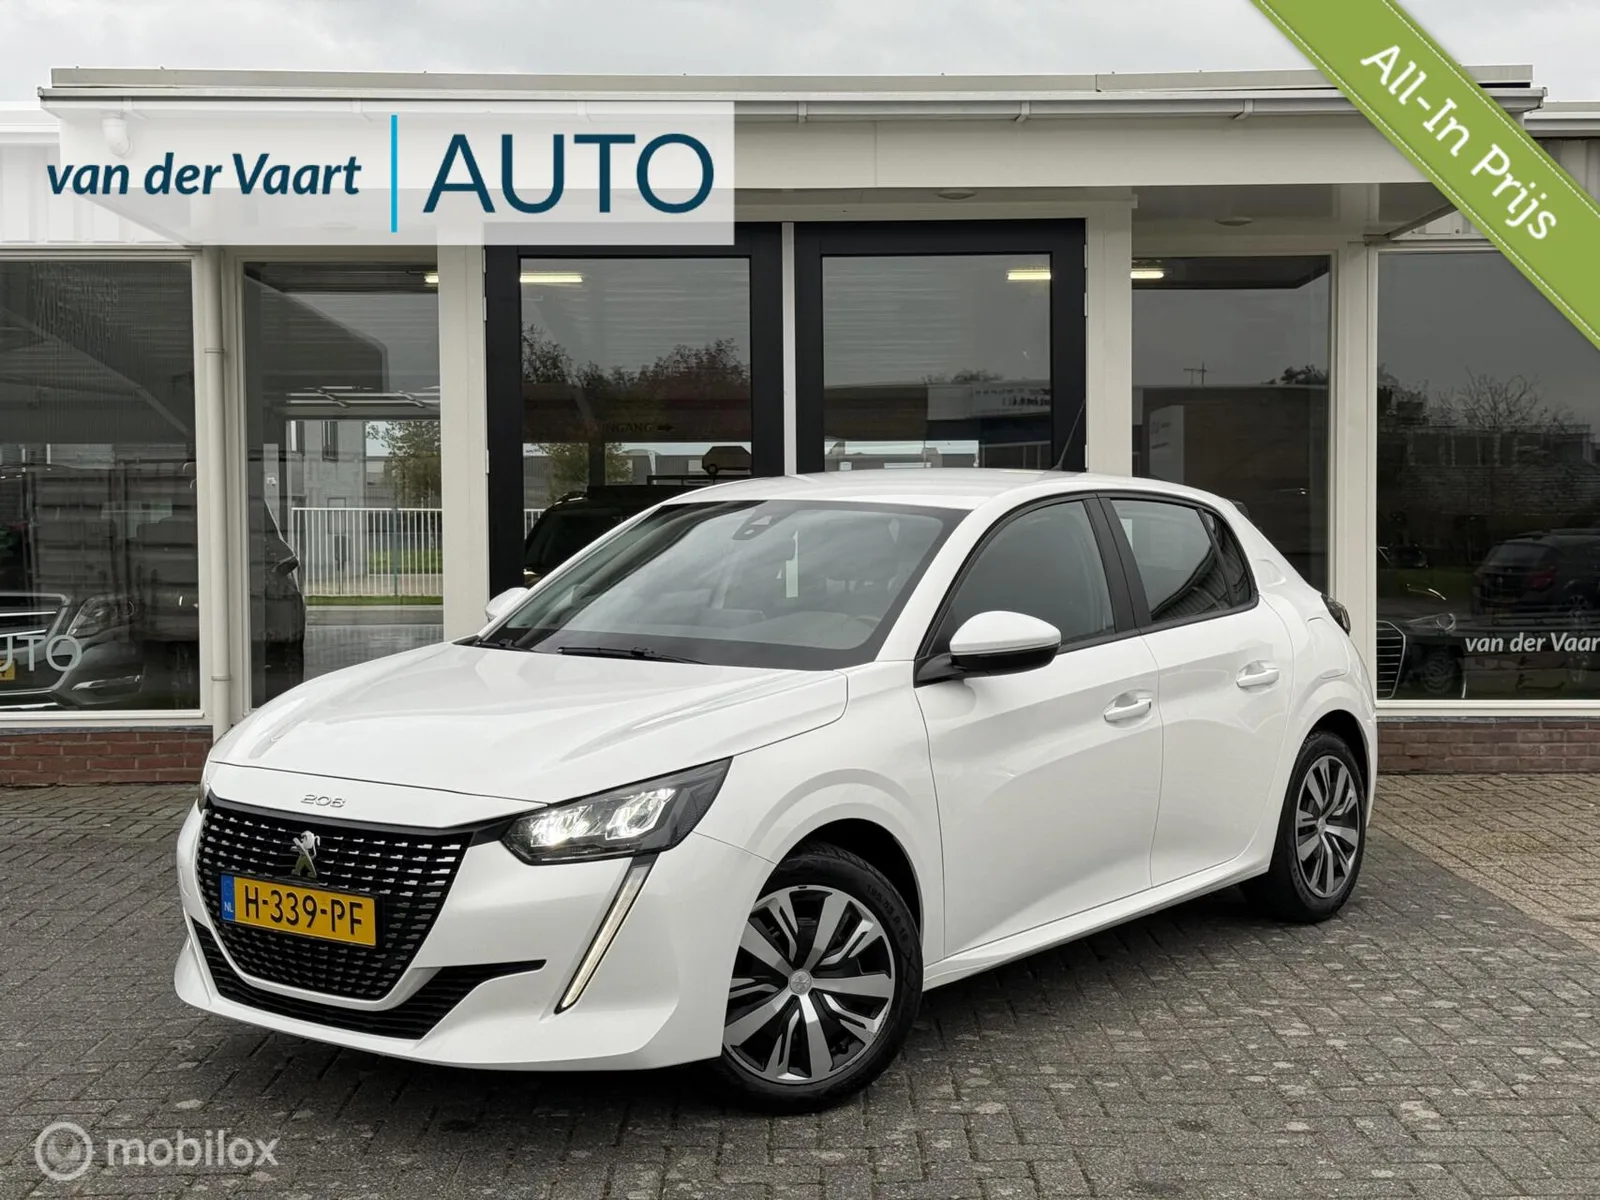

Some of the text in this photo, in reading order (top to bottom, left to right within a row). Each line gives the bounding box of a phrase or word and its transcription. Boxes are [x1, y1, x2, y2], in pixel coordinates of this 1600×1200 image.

[1465, 637, 1504, 652] van
[1509, 632, 1546, 652] der
[224, 901, 234, 913] NL
[244, 885, 363, 935] H-339-PF
